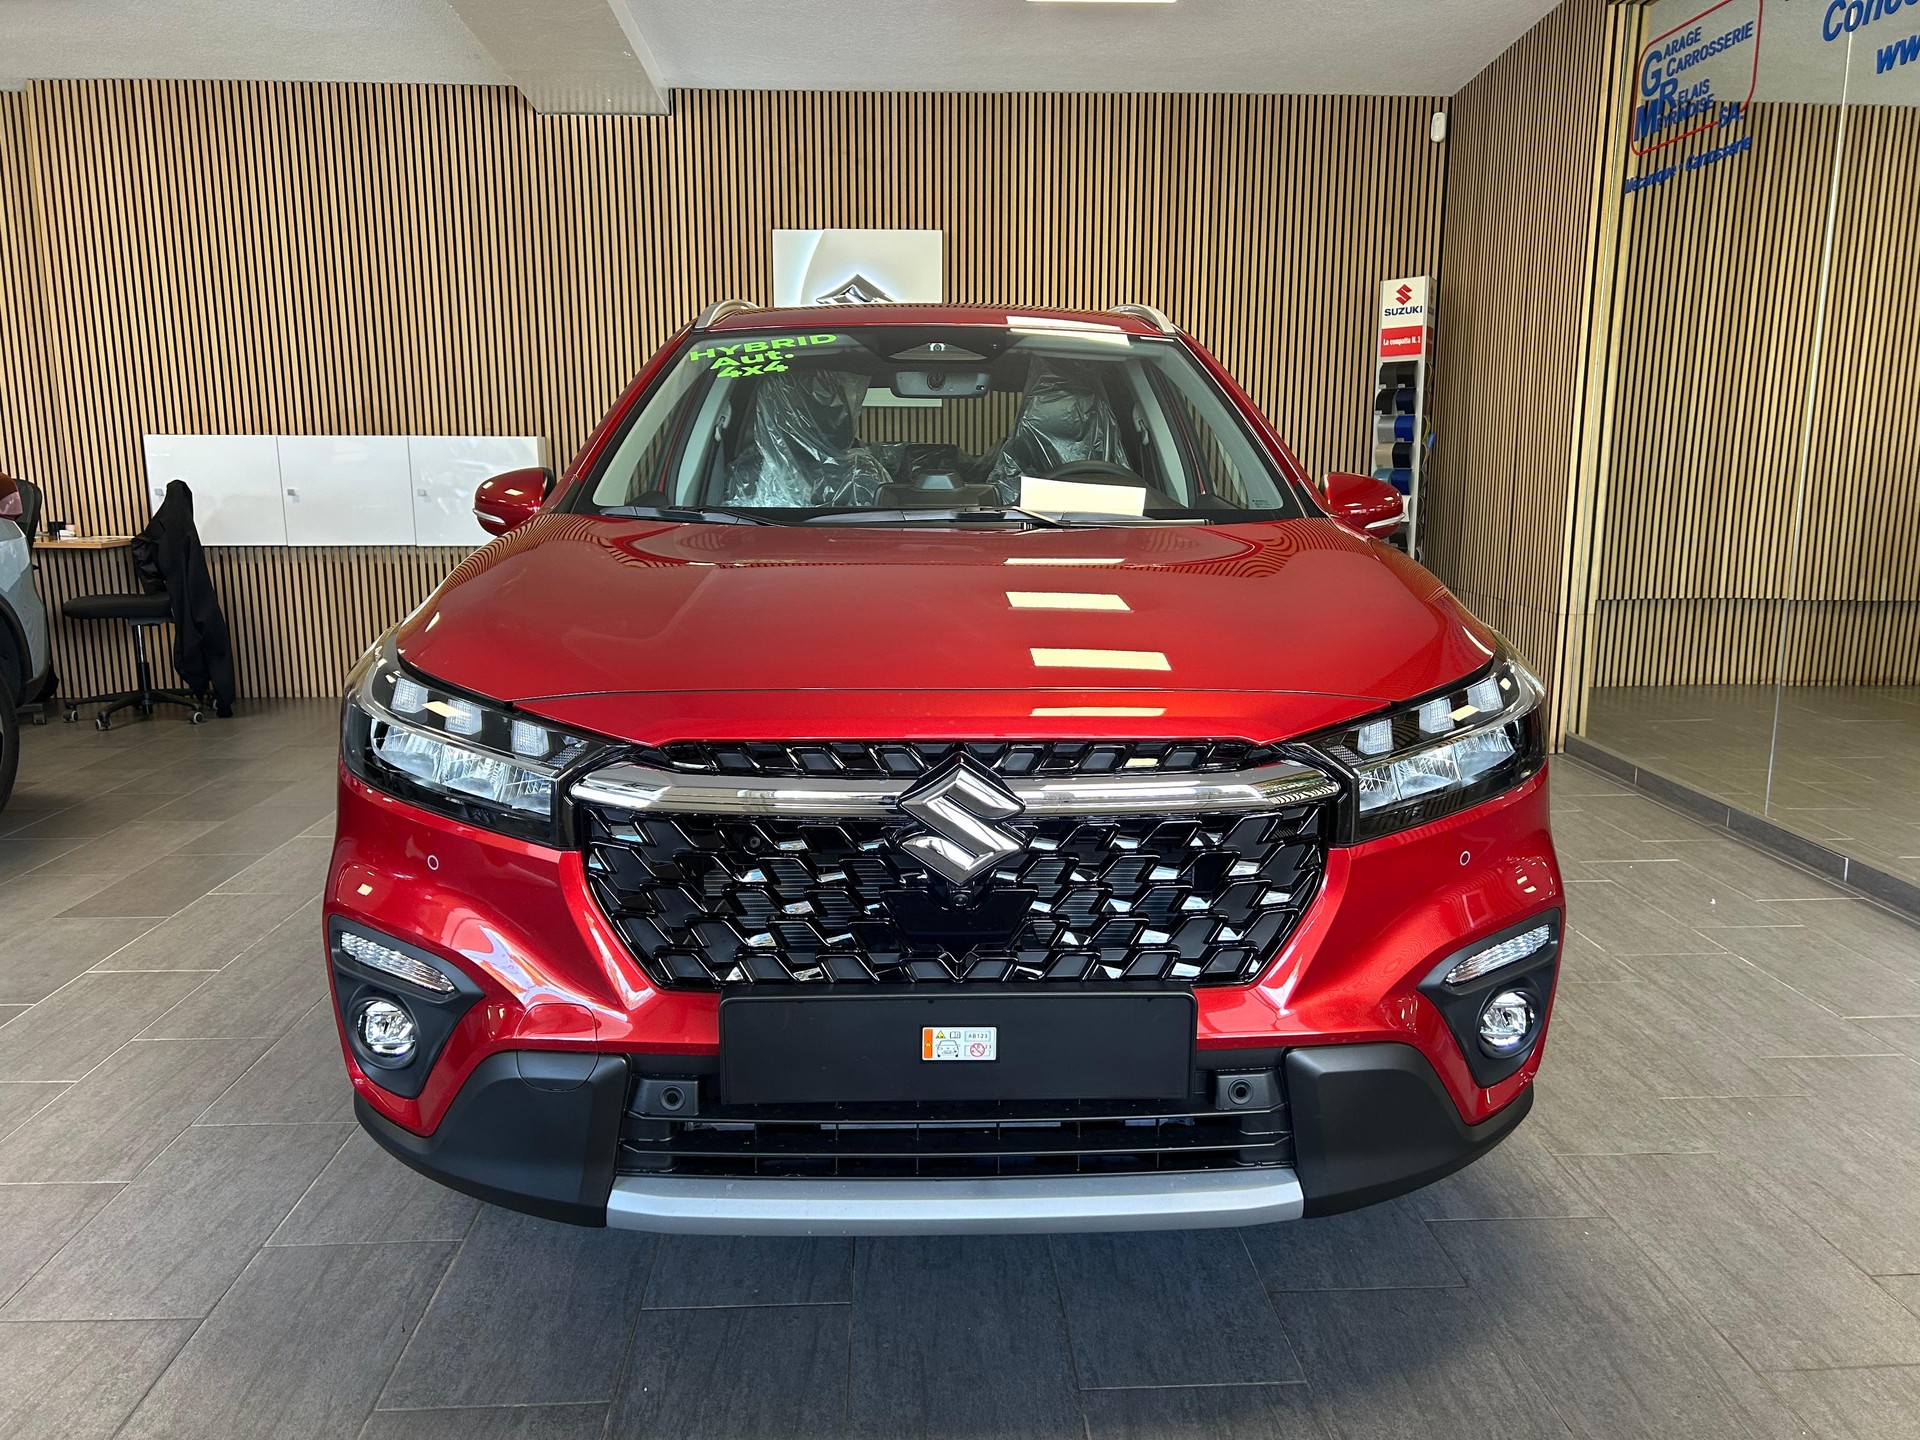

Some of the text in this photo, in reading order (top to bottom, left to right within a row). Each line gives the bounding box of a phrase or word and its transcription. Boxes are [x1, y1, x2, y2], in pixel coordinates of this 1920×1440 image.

[1641, 26, 1702, 97] GARAGE
[1666, 21, 1754, 77] CARROSSERIE
[1659, 78, 1710, 114] RELAIS
[1685, 134, 1752, 172] Carrosserie
[1384, 306, 1423, 316] SUZUKI
[689, 334, 837, 361] HYBRID
[710, 350, 795, 370] Aut.
[717, 361, 789, 378] 4x4
